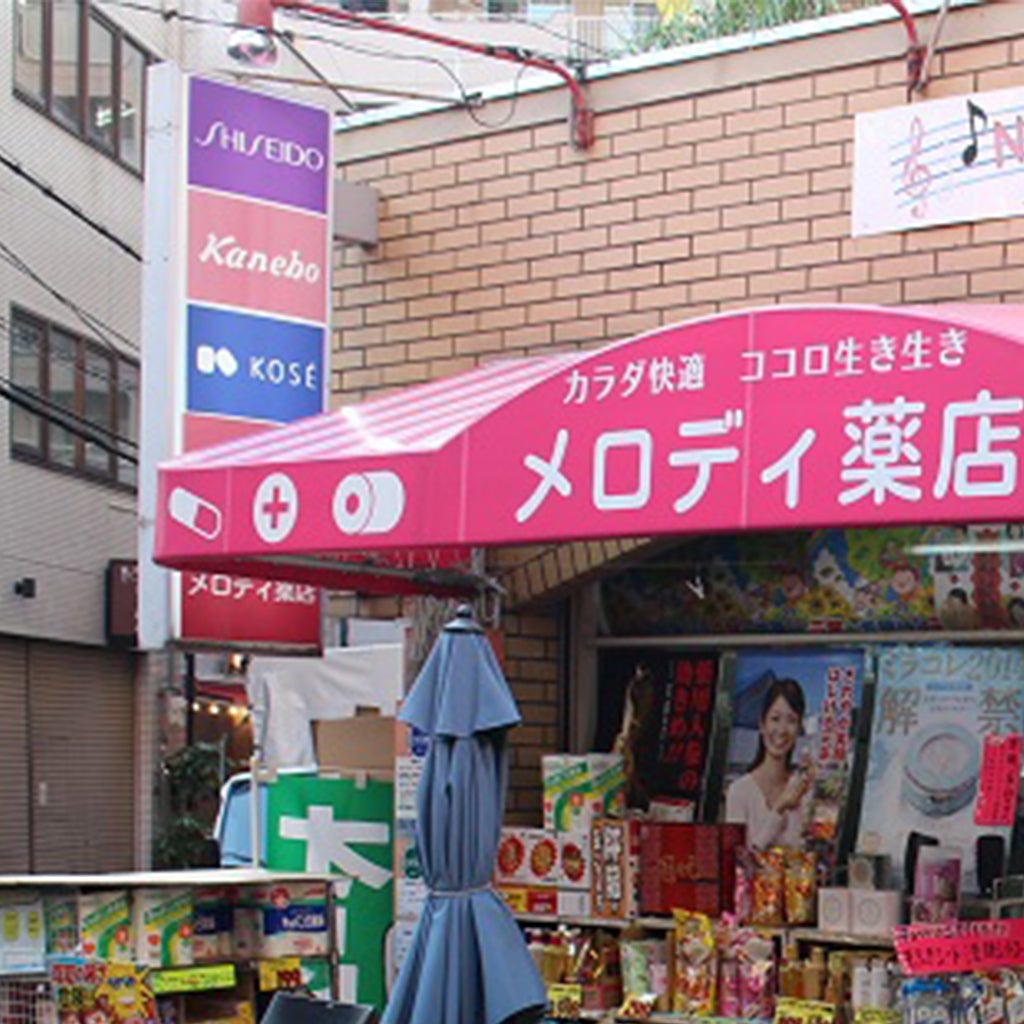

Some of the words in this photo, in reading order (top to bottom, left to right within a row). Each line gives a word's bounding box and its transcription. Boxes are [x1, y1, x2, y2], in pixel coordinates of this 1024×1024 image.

[194, 121, 325, 172] SHISEIDO
[199, 232, 321, 284] Kanebo
[563, 354, 705, 404] カラダ快適
[740, 328, 968, 383] ココロ生き生き
